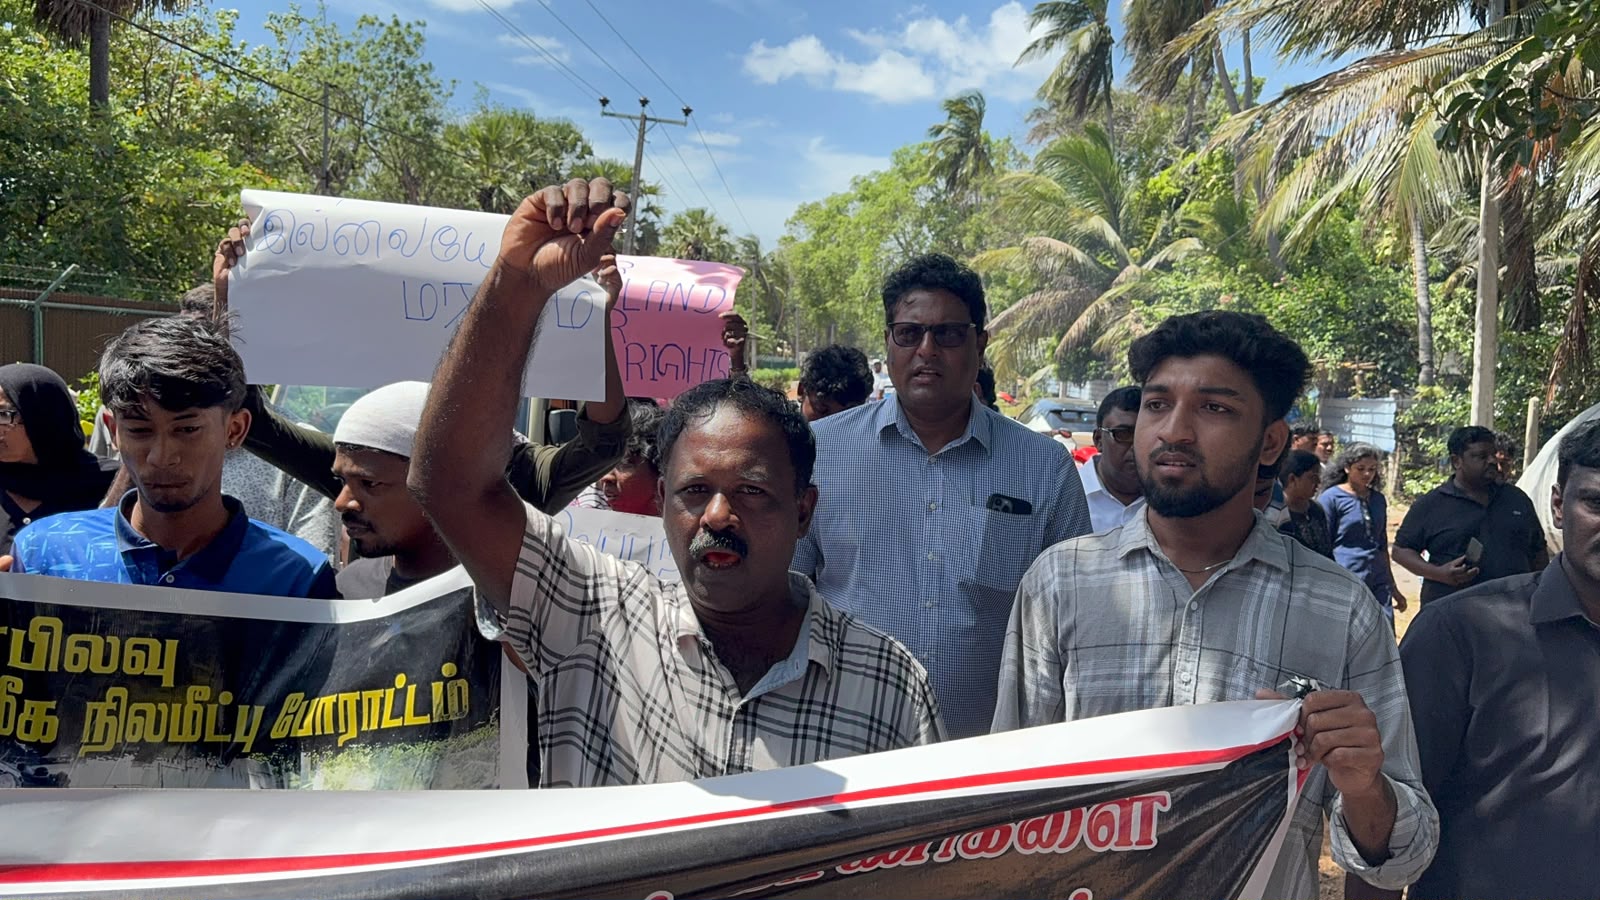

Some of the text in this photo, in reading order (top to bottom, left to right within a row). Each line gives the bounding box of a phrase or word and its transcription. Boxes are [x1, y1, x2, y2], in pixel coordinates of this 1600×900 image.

[622, 278, 727, 314] LAND
[625, 342, 730, 384] RIGHTS
[0, 615, 180, 688] பிலவு
[79, 684, 264, 757] நிலமீட்பு
[269, 661, 470, 748] போராட்டம்
